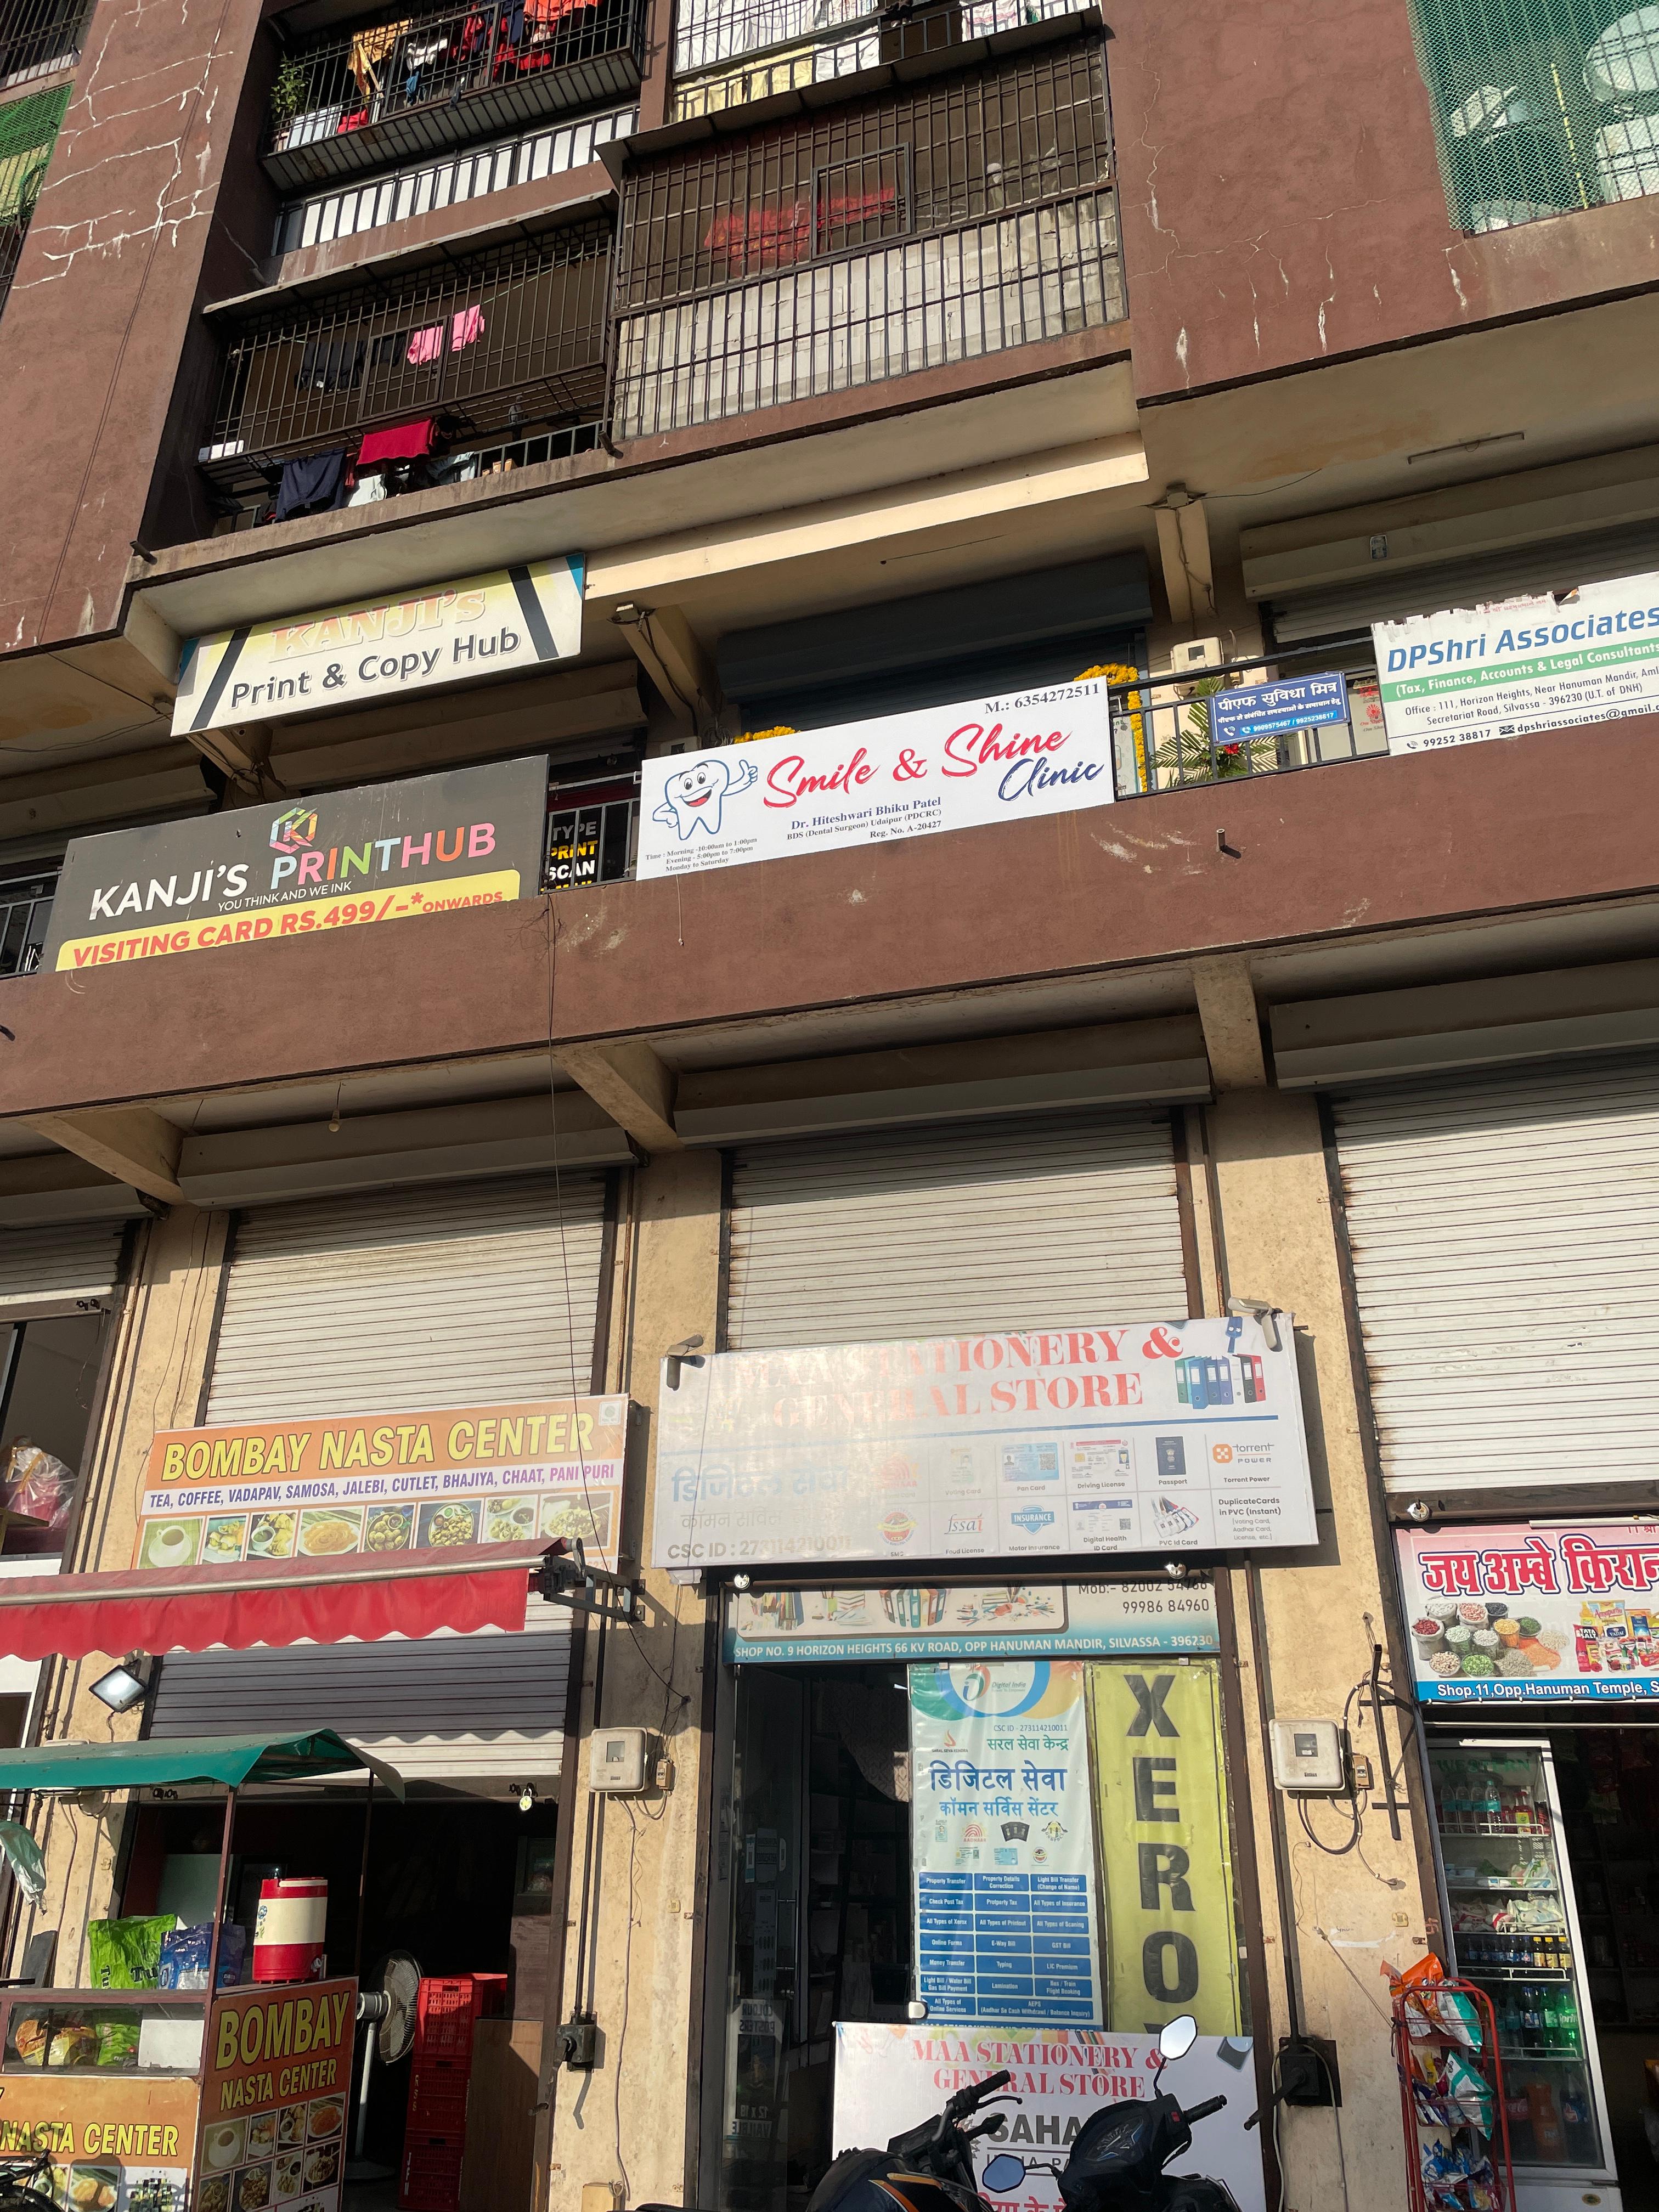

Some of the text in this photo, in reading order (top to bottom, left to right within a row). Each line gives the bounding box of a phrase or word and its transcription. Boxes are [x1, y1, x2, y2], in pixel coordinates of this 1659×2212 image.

[269, 589, 487, 662] KANJI's
[1387, 605, 1659, 673] DPShri Associates
[231, 627, 521, 710] Print & Copy Hub
[1396, 684, 1425, 698] (Tax,
[1428, 675, 1476, 690] Finance,
[1481, 664, 1533, 681] Accounts
[1537, 661, 1547, 672] &
[1550, 653, 1583, 669] Legal
[1587, 643, 1659, 663] Consultants
[985, 683, 1098, 714] M.: 6354272511
[1217, 681, 1339, 711] पीएफ सुविधा मित्र
[1405, 706, 1430, 715] Office
[1438, 700, 1458, 710] 111,
[1460, 696, 1494, 707] Horizon
[1496, 689, 1532, 701] Heights,
[1534, 685, 1556, 695] Near
[1559, 678, 1602, 691] Hanuman
[1605, 670, 1638, 683] Mandir,
[1426, 682, 1643, 725] Secretariat Road, Silvassa 396230 (U.T. of DNH)
[1423, 729, 1491, 747] 99252 38817
[764, 724, 1069, 808] Smile & Shine
[998, 758, 1102, 800] Clinic
[787, 809, 941, 840] BDS (Dental Surgeon) Udaipur (PDCRC)
[791, 797, 941, 830] Dr. Hiteshwari Bhiku Patel
[907, 820, 941, 832] A-20427
[88, 822, 496, 921] KANJI'S PRINTHUB
[665, 864, 690, 872] Monday
[700, 857, 728, 866] Saturday
[666, 856, 691, 865] Evening
[218, 881, 352, 912] YOU THINK AND WE INK
[74, 930, 190, 967] VISITING
[197, 917, 273, 947] CARD
[422, 891, 503, 913] ONWARDS
[1142, 1326, 1183, 1359] &
[991, 1372, 1144, 1415] STORE
[161, 1412, 595, 1481] BOMBAY NASTA CENTER
[1232, 1442, 1274, 1452] torrent
[150, 1464, 614, 1509] TEA, COFFEE, VADAPAV, SAMOSA, JALEBI, CUTLET, BHAJIYA, CHAAT, PANI PURI
[1218, 1497, 1280, 1506] DuplicateCards
[1014, 1512, 1052, 1523] INSURANCE
[1246, 1506, 1281, 1516] (Instant)
[1418, 1551, 1482, 1597] जय
[1481, 1537, 1559, 1597] अम्बे
[1122, 1599, 1209, 1614] 99986 84960
[735, 1635, 1212, 1657] SHOP NO. 9 HORIZON HEIGHTS 66 KV ROAD, OPP HANUMAN MANDIR, SILVASSA 396230
[1593, 1681, 1646, 1695] Temple,
[986, 1734, 1069, 1751] सरल सेवा केन्द्र
[929, 1759, 1068, 1791] डिजिटल सेवा
[939, 1796, 1059, 1817] कॉमन सर्विस सेंटर
[1123, 1674, 1199, 2033] XERO
[216, 1992, 350, 2069] BOMBAY
[913, 2040, 970, 2062] MAA
[977, 2041, 1138, 2069] STATIONERY
[220, 2058, 337, 2112] NASTA CENTER
[933, 2068, 1145, 2098] GENRAL STORE
[0, 2120, 179, 2156] NASTA CENTER
